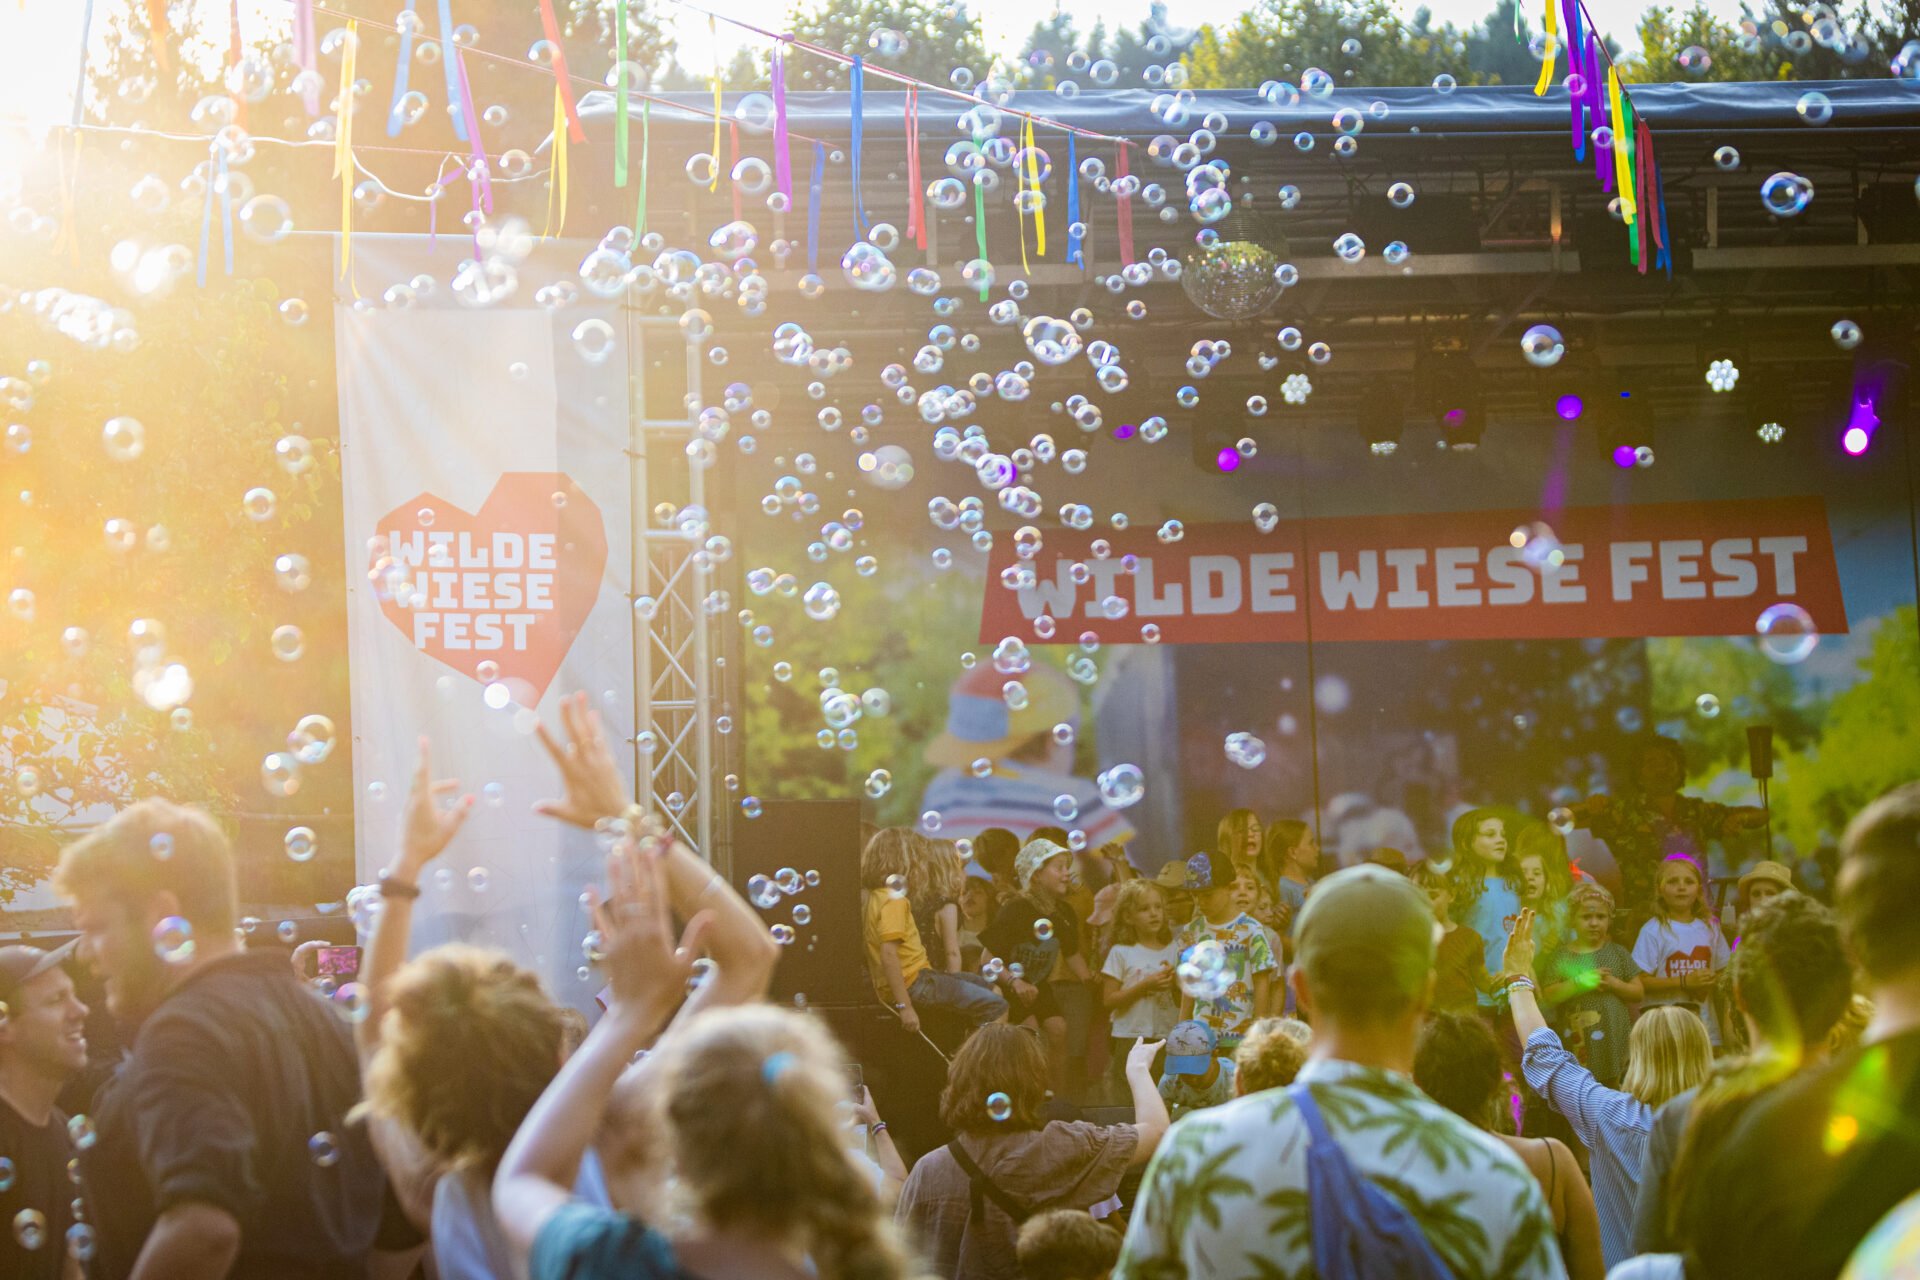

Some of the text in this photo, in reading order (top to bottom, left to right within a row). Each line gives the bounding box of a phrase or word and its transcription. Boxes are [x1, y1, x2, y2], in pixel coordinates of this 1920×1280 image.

[389, 530, 557, 570] WILDE
[1016, 536, 1808, 619] WILDE WIESE FEST
[413, 612, 536, 651] FEST
